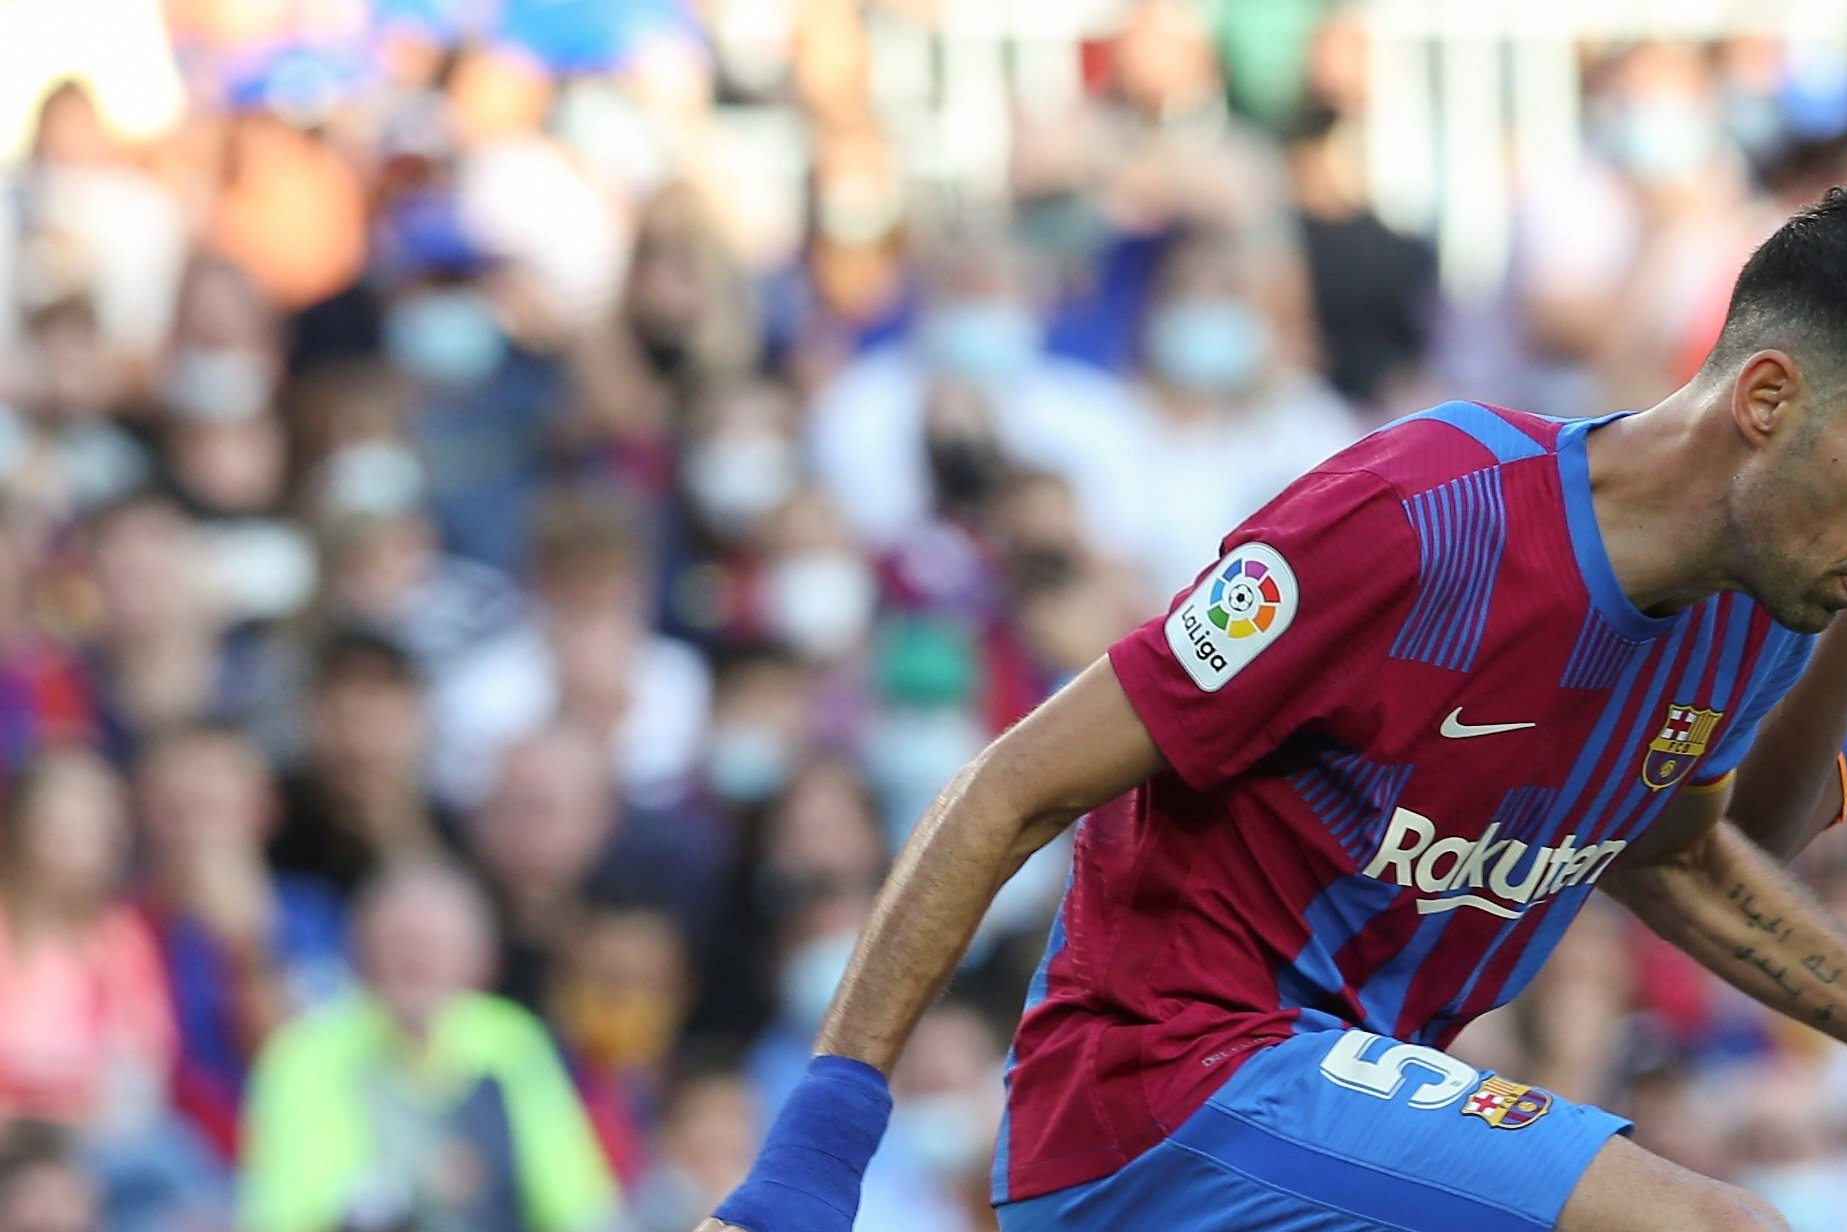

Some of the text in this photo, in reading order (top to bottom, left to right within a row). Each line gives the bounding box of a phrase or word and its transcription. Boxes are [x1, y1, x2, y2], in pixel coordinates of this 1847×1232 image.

[1181, 604, 1228, 673] LaLiga
[1362, 806, 1627, 904] Rakuten
[1319, 1028, 1480, 1110] 5
